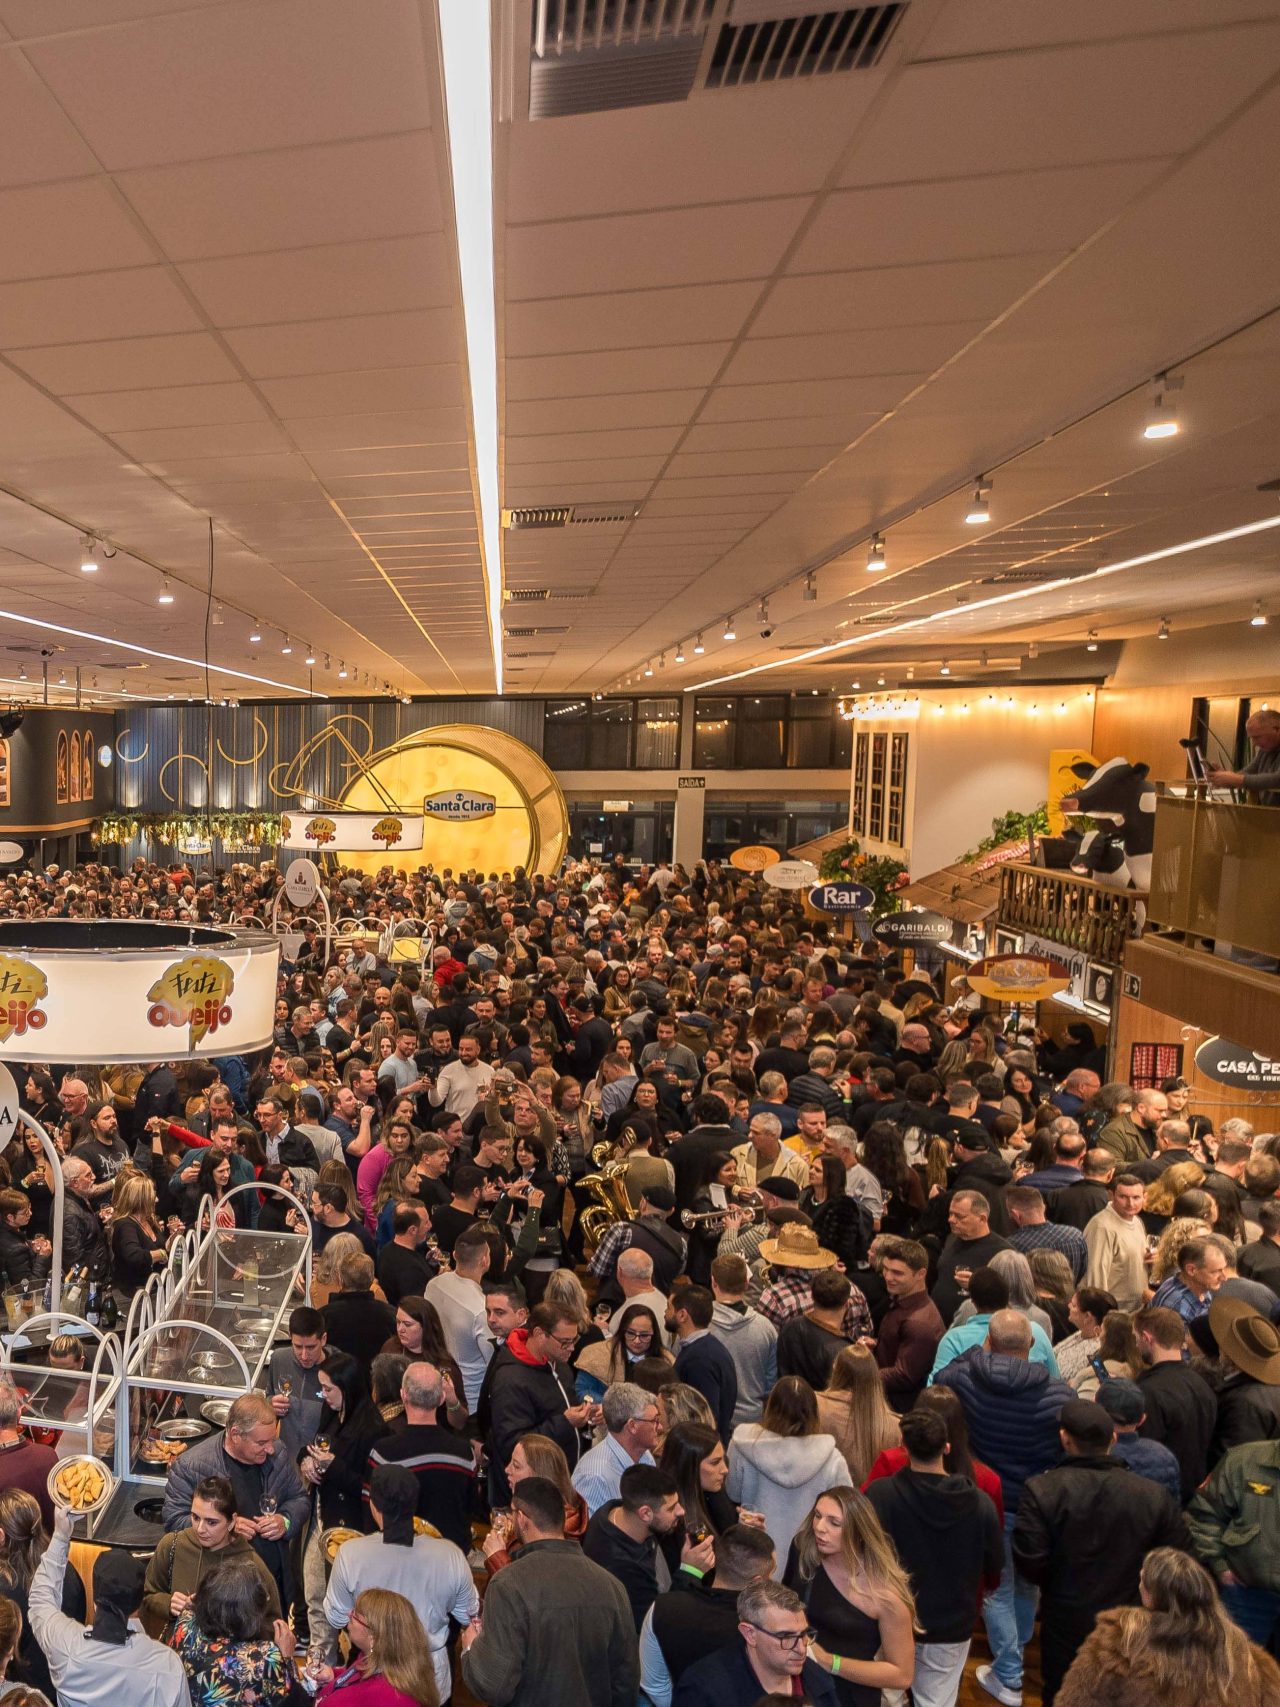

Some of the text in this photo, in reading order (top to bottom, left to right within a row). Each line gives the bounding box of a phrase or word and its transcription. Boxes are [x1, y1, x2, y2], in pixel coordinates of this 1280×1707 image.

[426, 800, 494, 812] Santa Clara
[824, 886, 861, 905] Rar
[891, 923, 949, 933] GARIBALDI
[169, 971, 222, 998] Festi
[147, 999, 233, 1035] Queijo
[1216, 1060, 1258, 1073] CASA
